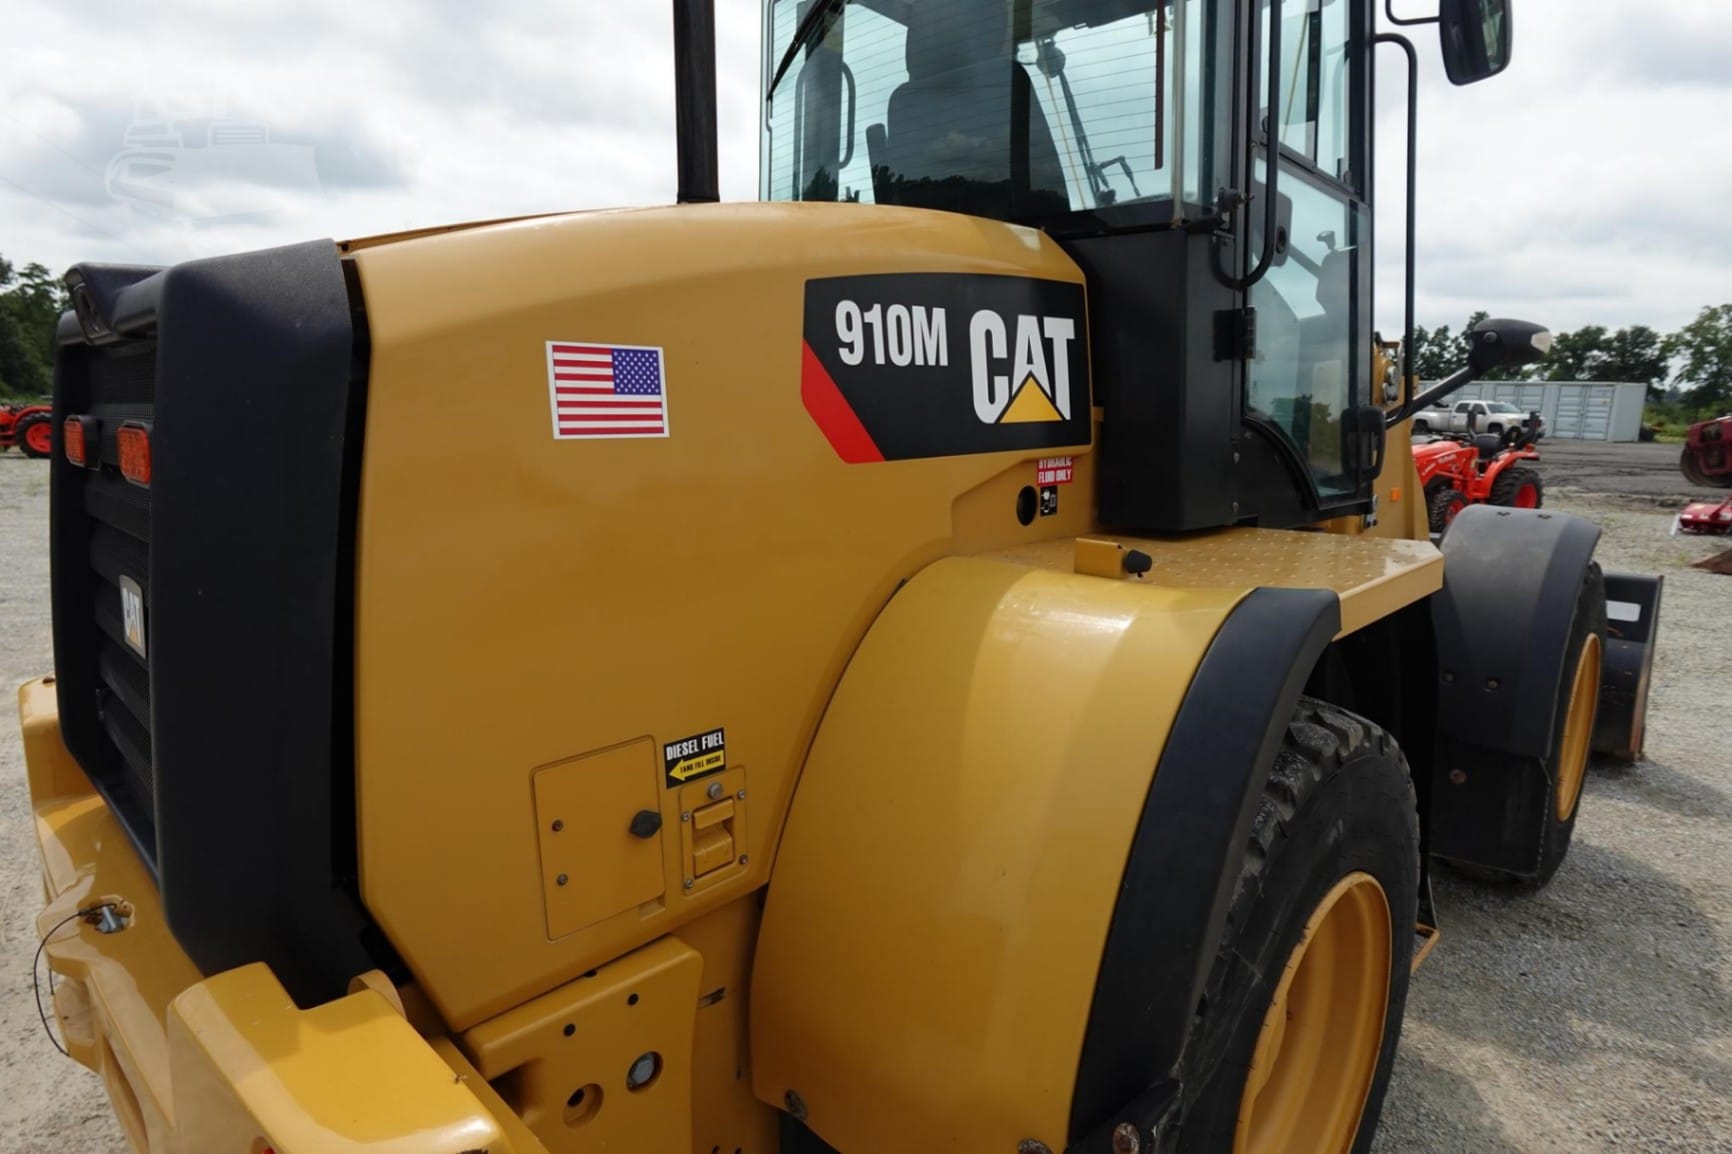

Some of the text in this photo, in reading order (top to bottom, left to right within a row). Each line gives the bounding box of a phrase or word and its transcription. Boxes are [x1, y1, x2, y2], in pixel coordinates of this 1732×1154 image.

[835, 300, 949, 367] 910M
[969, 309, 1076, 424] CAT
[1038, 469, 1072, 483] FLUID ONLY
[666, 732, 724, 760] DIESEL FUEL
